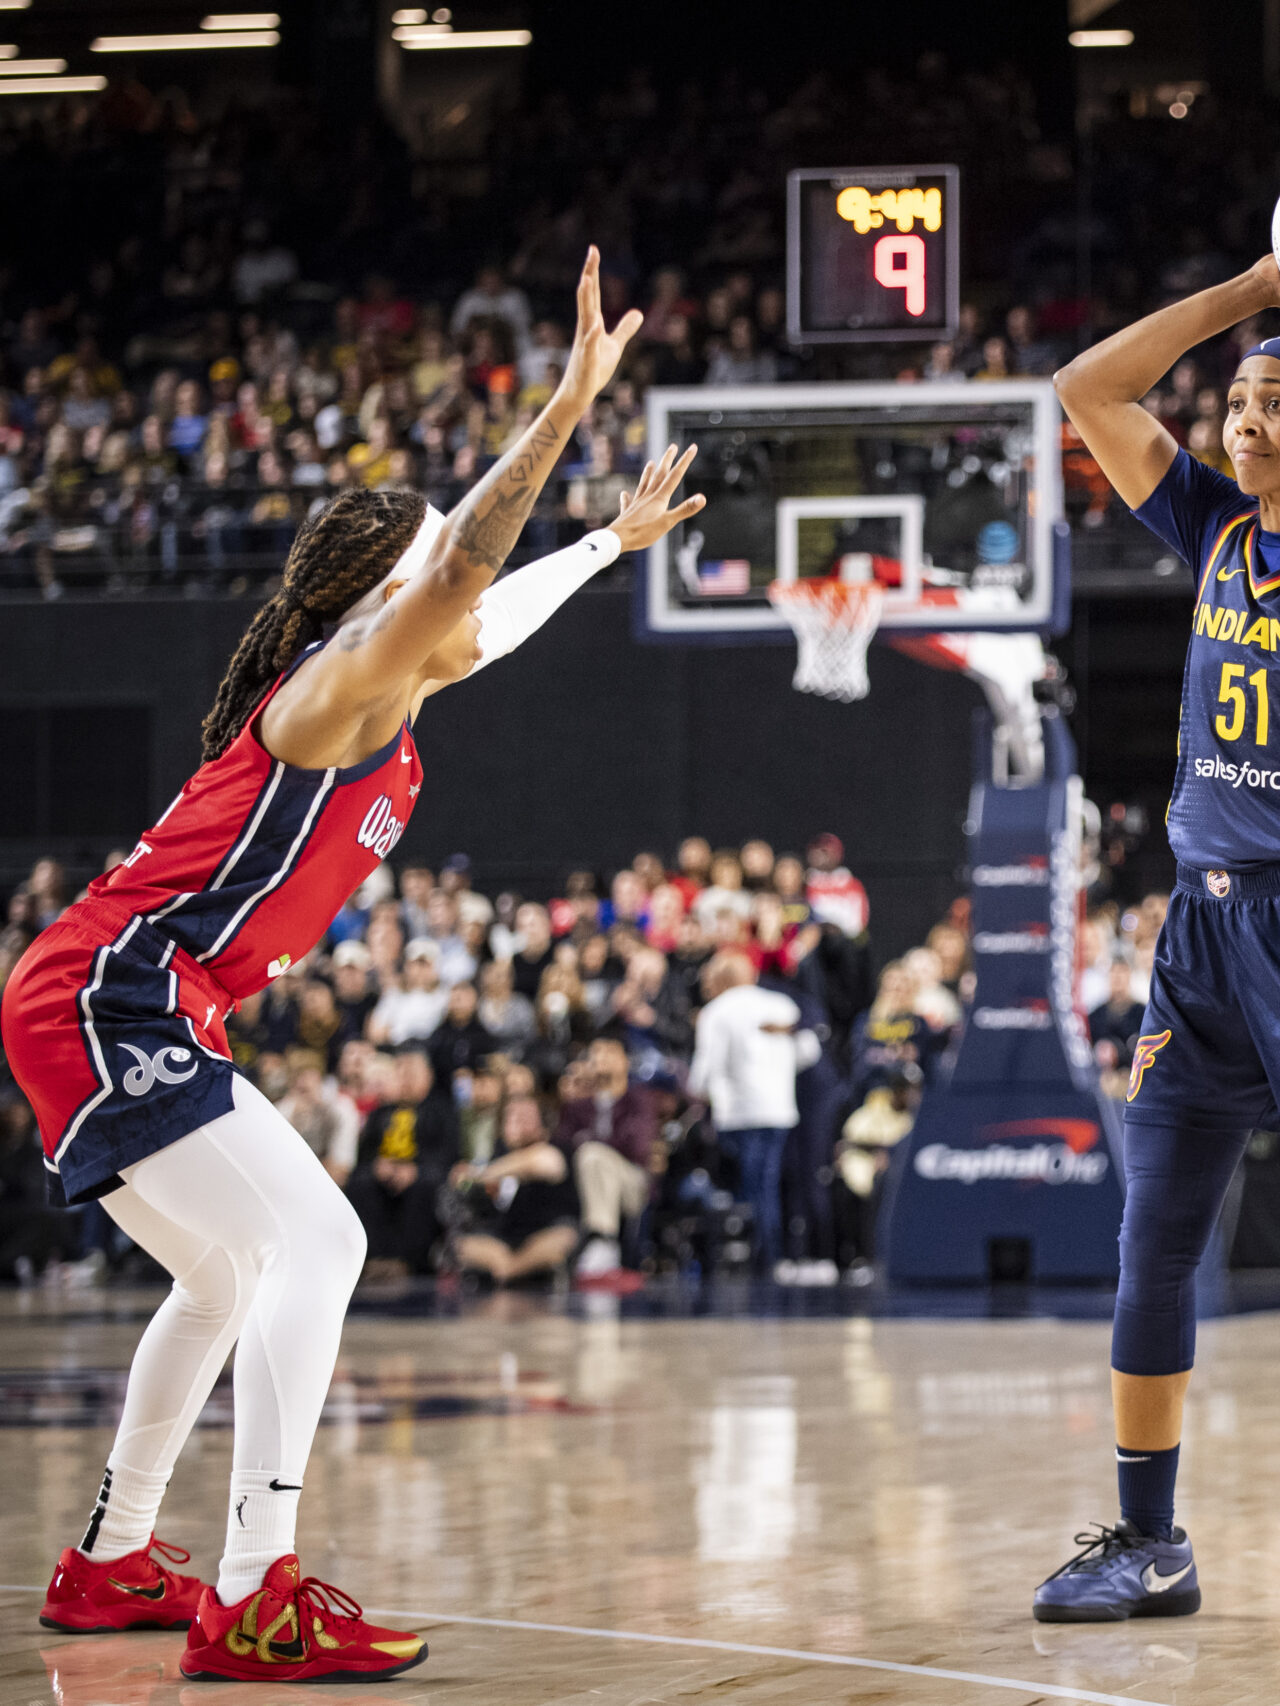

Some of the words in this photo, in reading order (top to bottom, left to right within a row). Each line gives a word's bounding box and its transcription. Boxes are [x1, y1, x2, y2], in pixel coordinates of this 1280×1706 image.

[836, 186, 942, 235] 9:44
[874, 234, 926, 317] 9
[1215, 662, 1269, 746] 51
